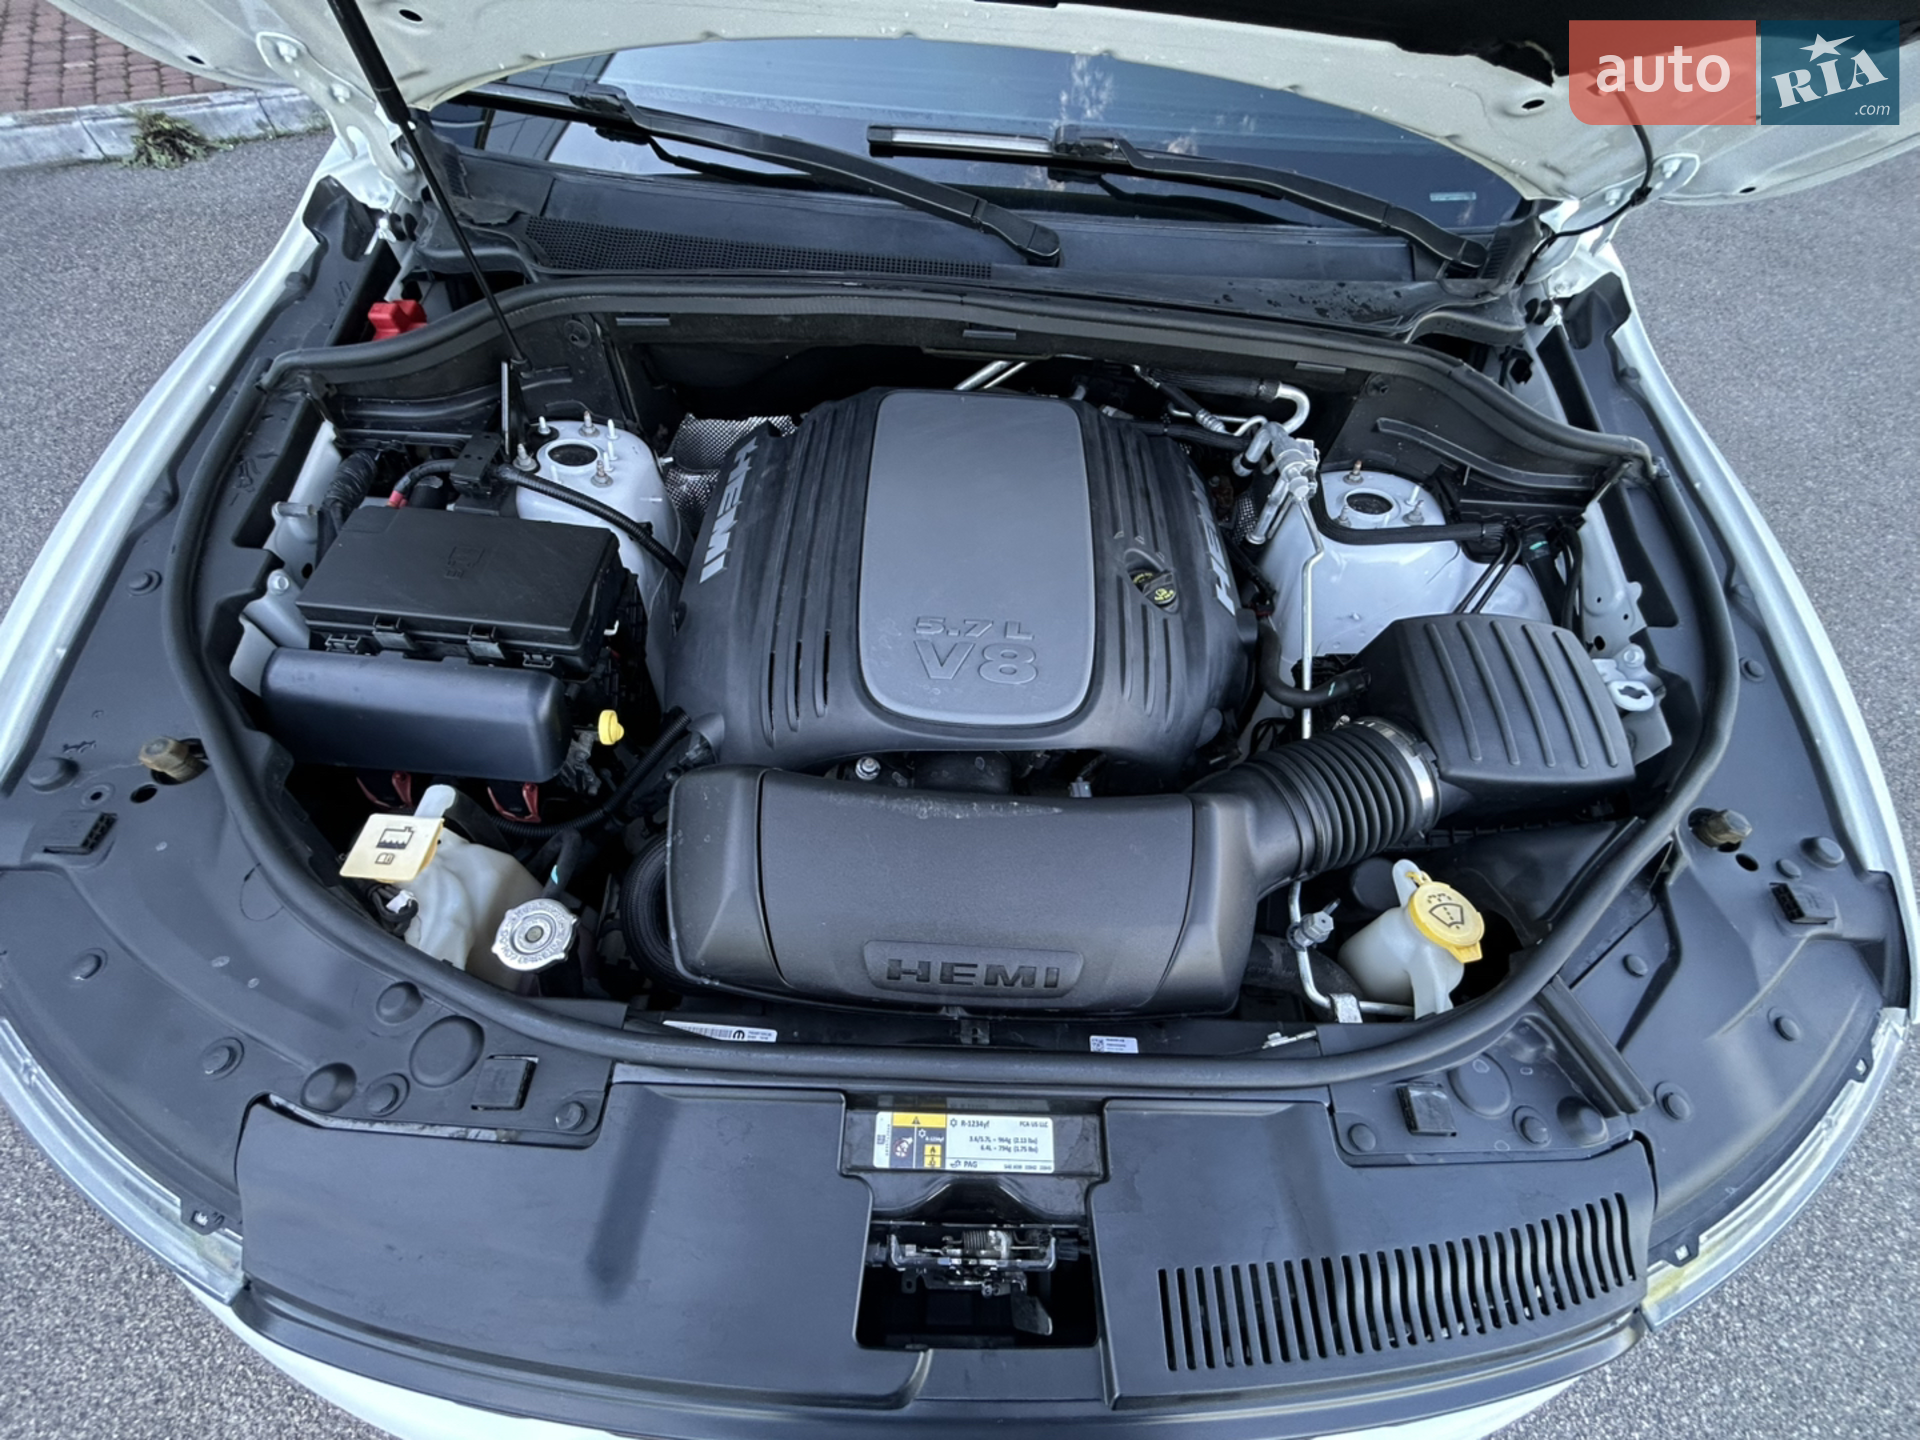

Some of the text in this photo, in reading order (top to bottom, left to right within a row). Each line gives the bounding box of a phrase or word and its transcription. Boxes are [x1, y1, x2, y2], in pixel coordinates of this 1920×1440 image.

[913, 639, 1039, 685] V8
[886, 958, 1060, 989] HEMI
[963, 1160, 978, 1168] PAG
